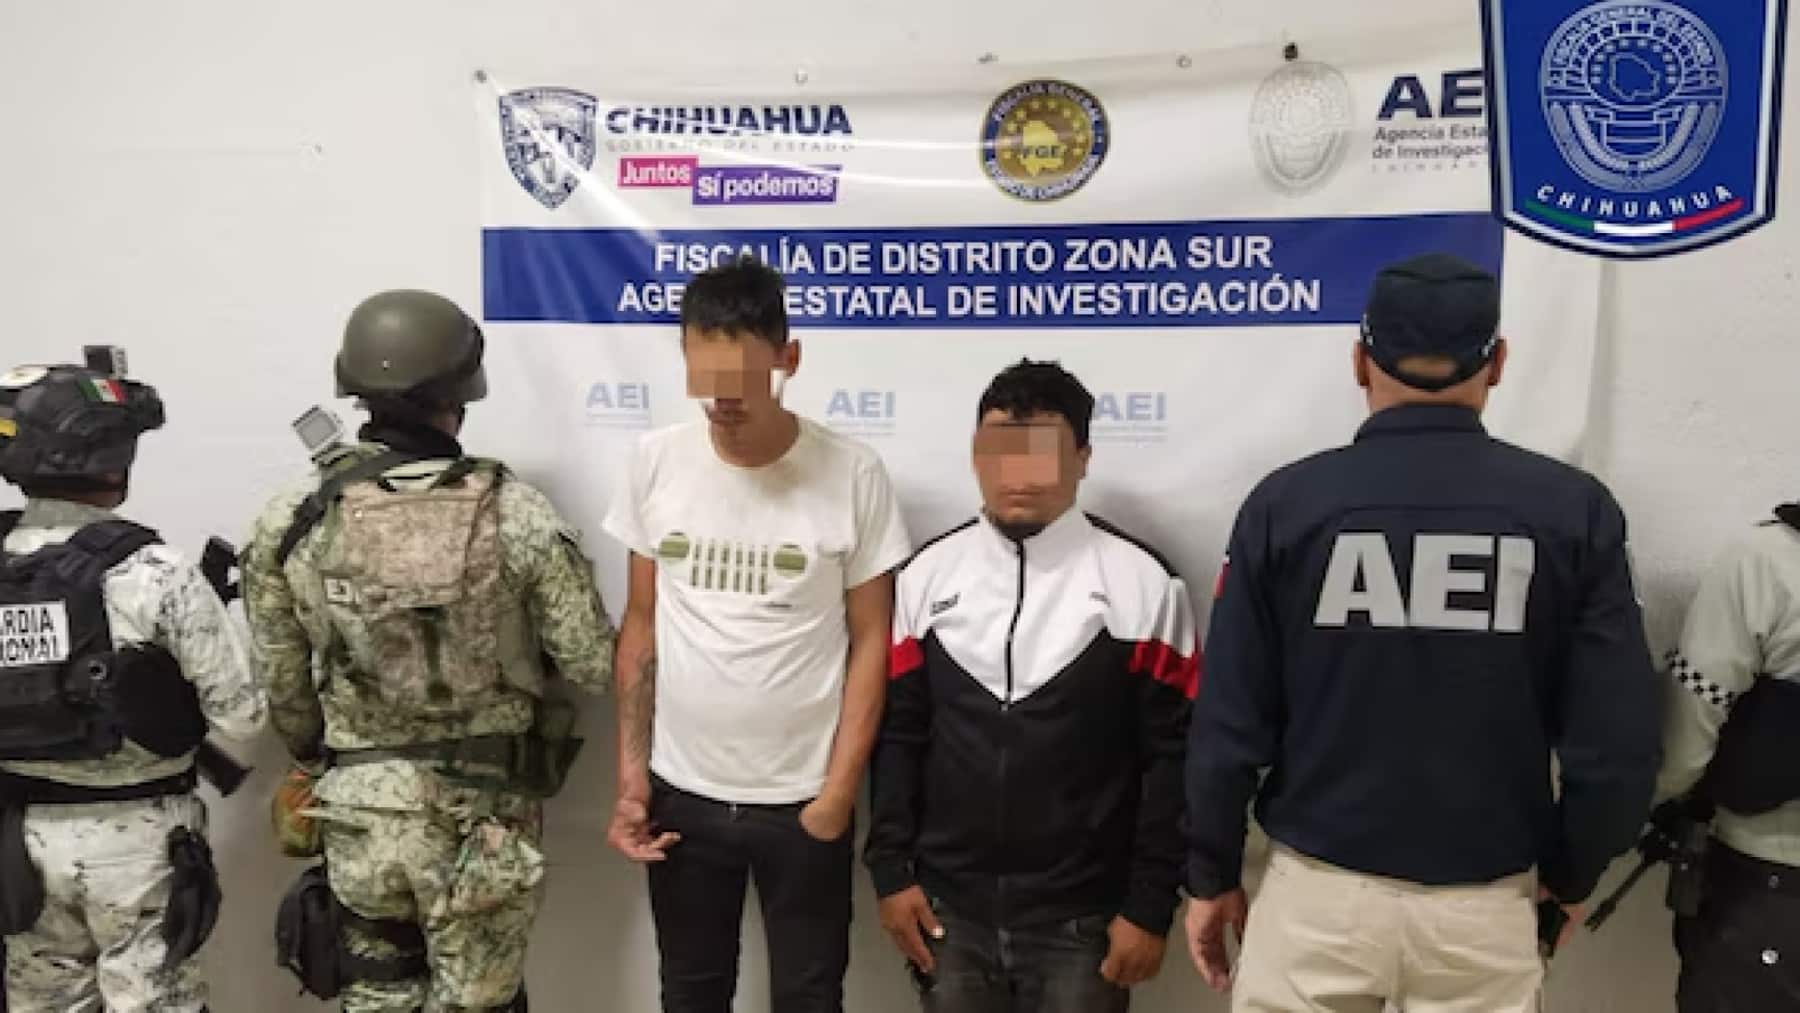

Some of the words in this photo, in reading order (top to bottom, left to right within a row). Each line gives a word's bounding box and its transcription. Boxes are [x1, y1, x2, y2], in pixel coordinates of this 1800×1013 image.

[1376, 73, 1482, 120] AE
[606, 104, 853, 135] CHIHUAHUA
[1375, 124, 1446, 143] Agencia
[1450, 123, 1488, 139] Esta
[1373, 145, 1394, 159] de
[622, 161, 691, 184] Juntos
[724, 171, 833, 202] podemos
[823, 242, 871, 274] DE
[882, 240, 1055, 274] DISTRITO
[1064, 237, 1177, 272] ZONA
[1188, 236, 1273, 269] SUR
[785, 285, 936, 316] ESTATAL
[947, 284, 997, 316] DE
[1010, 272, 1320, 316] INVESTIGACIÓN
[586, 382, 649, 409] AEI
[826, 389, 895, 418] AEI
[1094, 392, 1167, 421] AEI
[1314, 533, 1535, 632] AEI
[0, 607, 54, 635] RDIA
